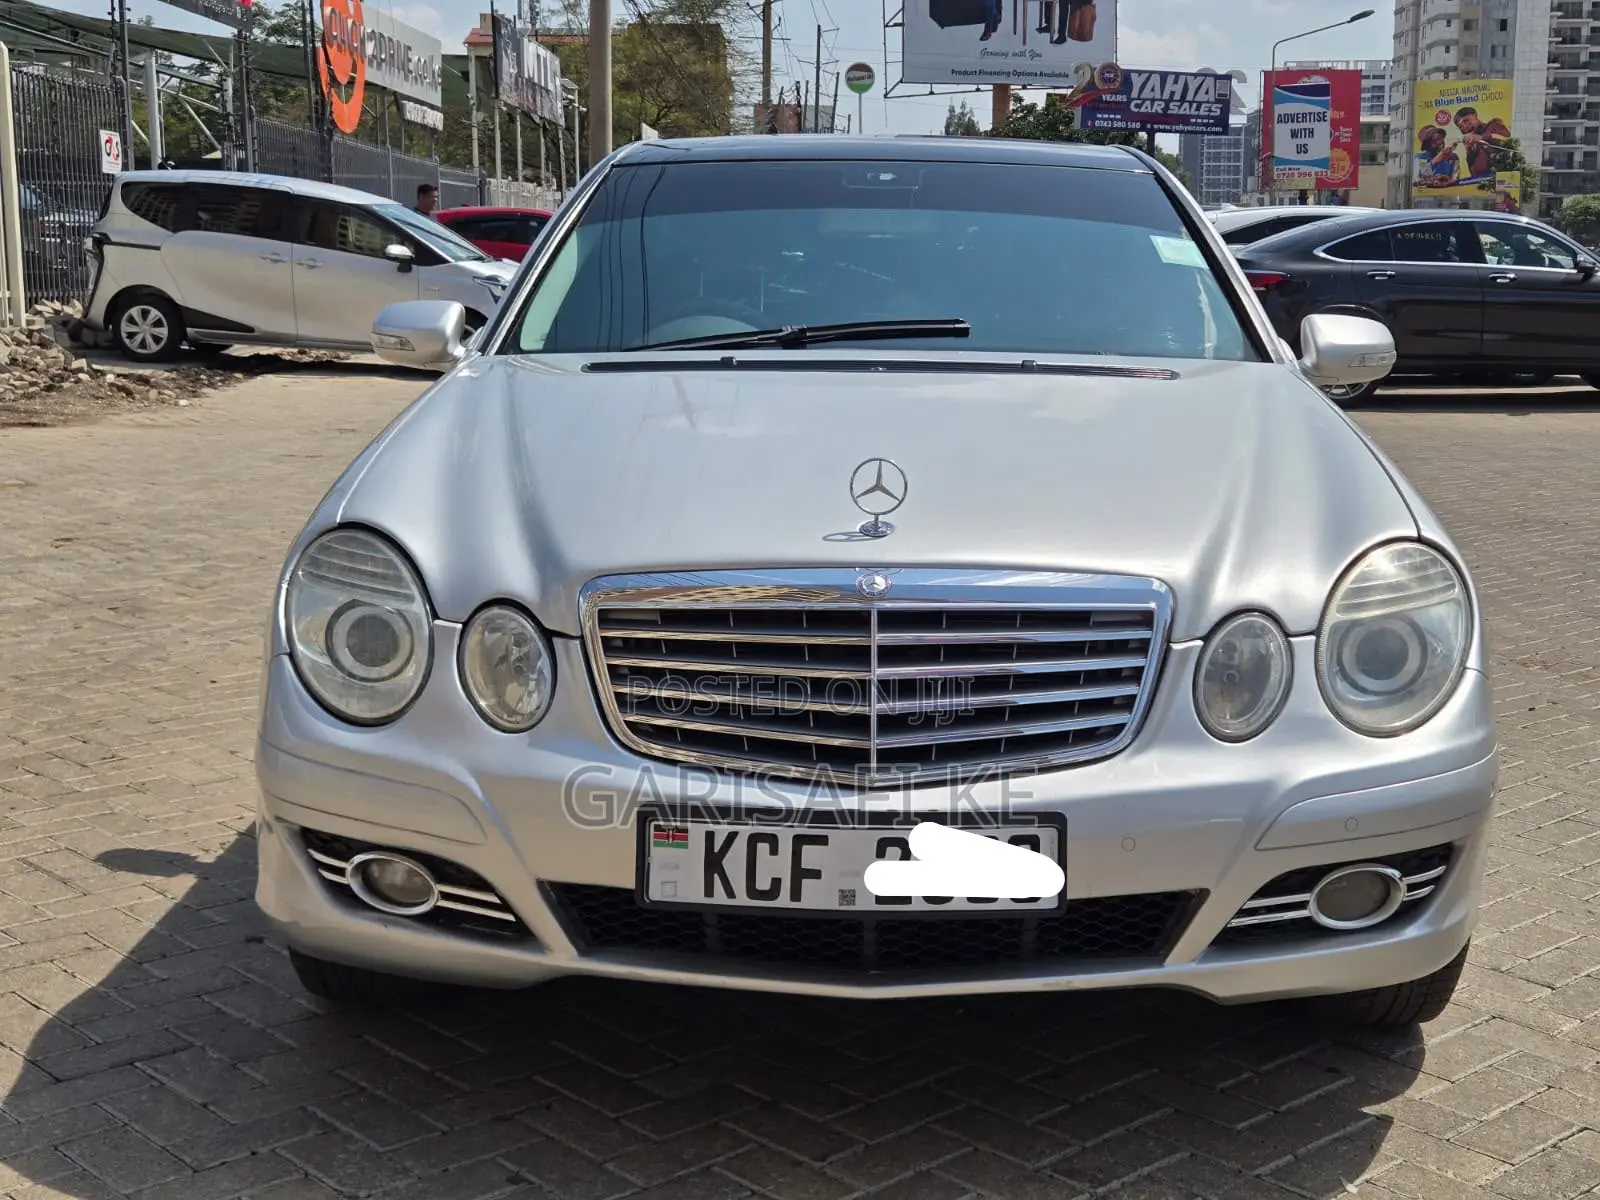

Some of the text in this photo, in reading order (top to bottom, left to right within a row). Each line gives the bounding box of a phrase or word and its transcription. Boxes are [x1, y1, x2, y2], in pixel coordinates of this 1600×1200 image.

[980, 47, 1042, 60] Growing with You
[951, 68, 1069, 79] Product Financing Options Available
[1130, 72, 1215, 102] YAHYA
[1101, 94, 1128, 102] YEARS
[1434, 98, 1455, 108] Blue
[1456, 94, 1479, 104] Band
[1482, 91, 1504, 102] CHOCO
[1130, 100, 1165, 114] CAR
[1167, 101, 1223, 116] SALES
[1276, 111, 1328, 124] ADVERTISE
[1290, 127, 1314, 139] WITH
[1296, 143, 1309, 154] US
[703, 829, 830, 903] KCF
